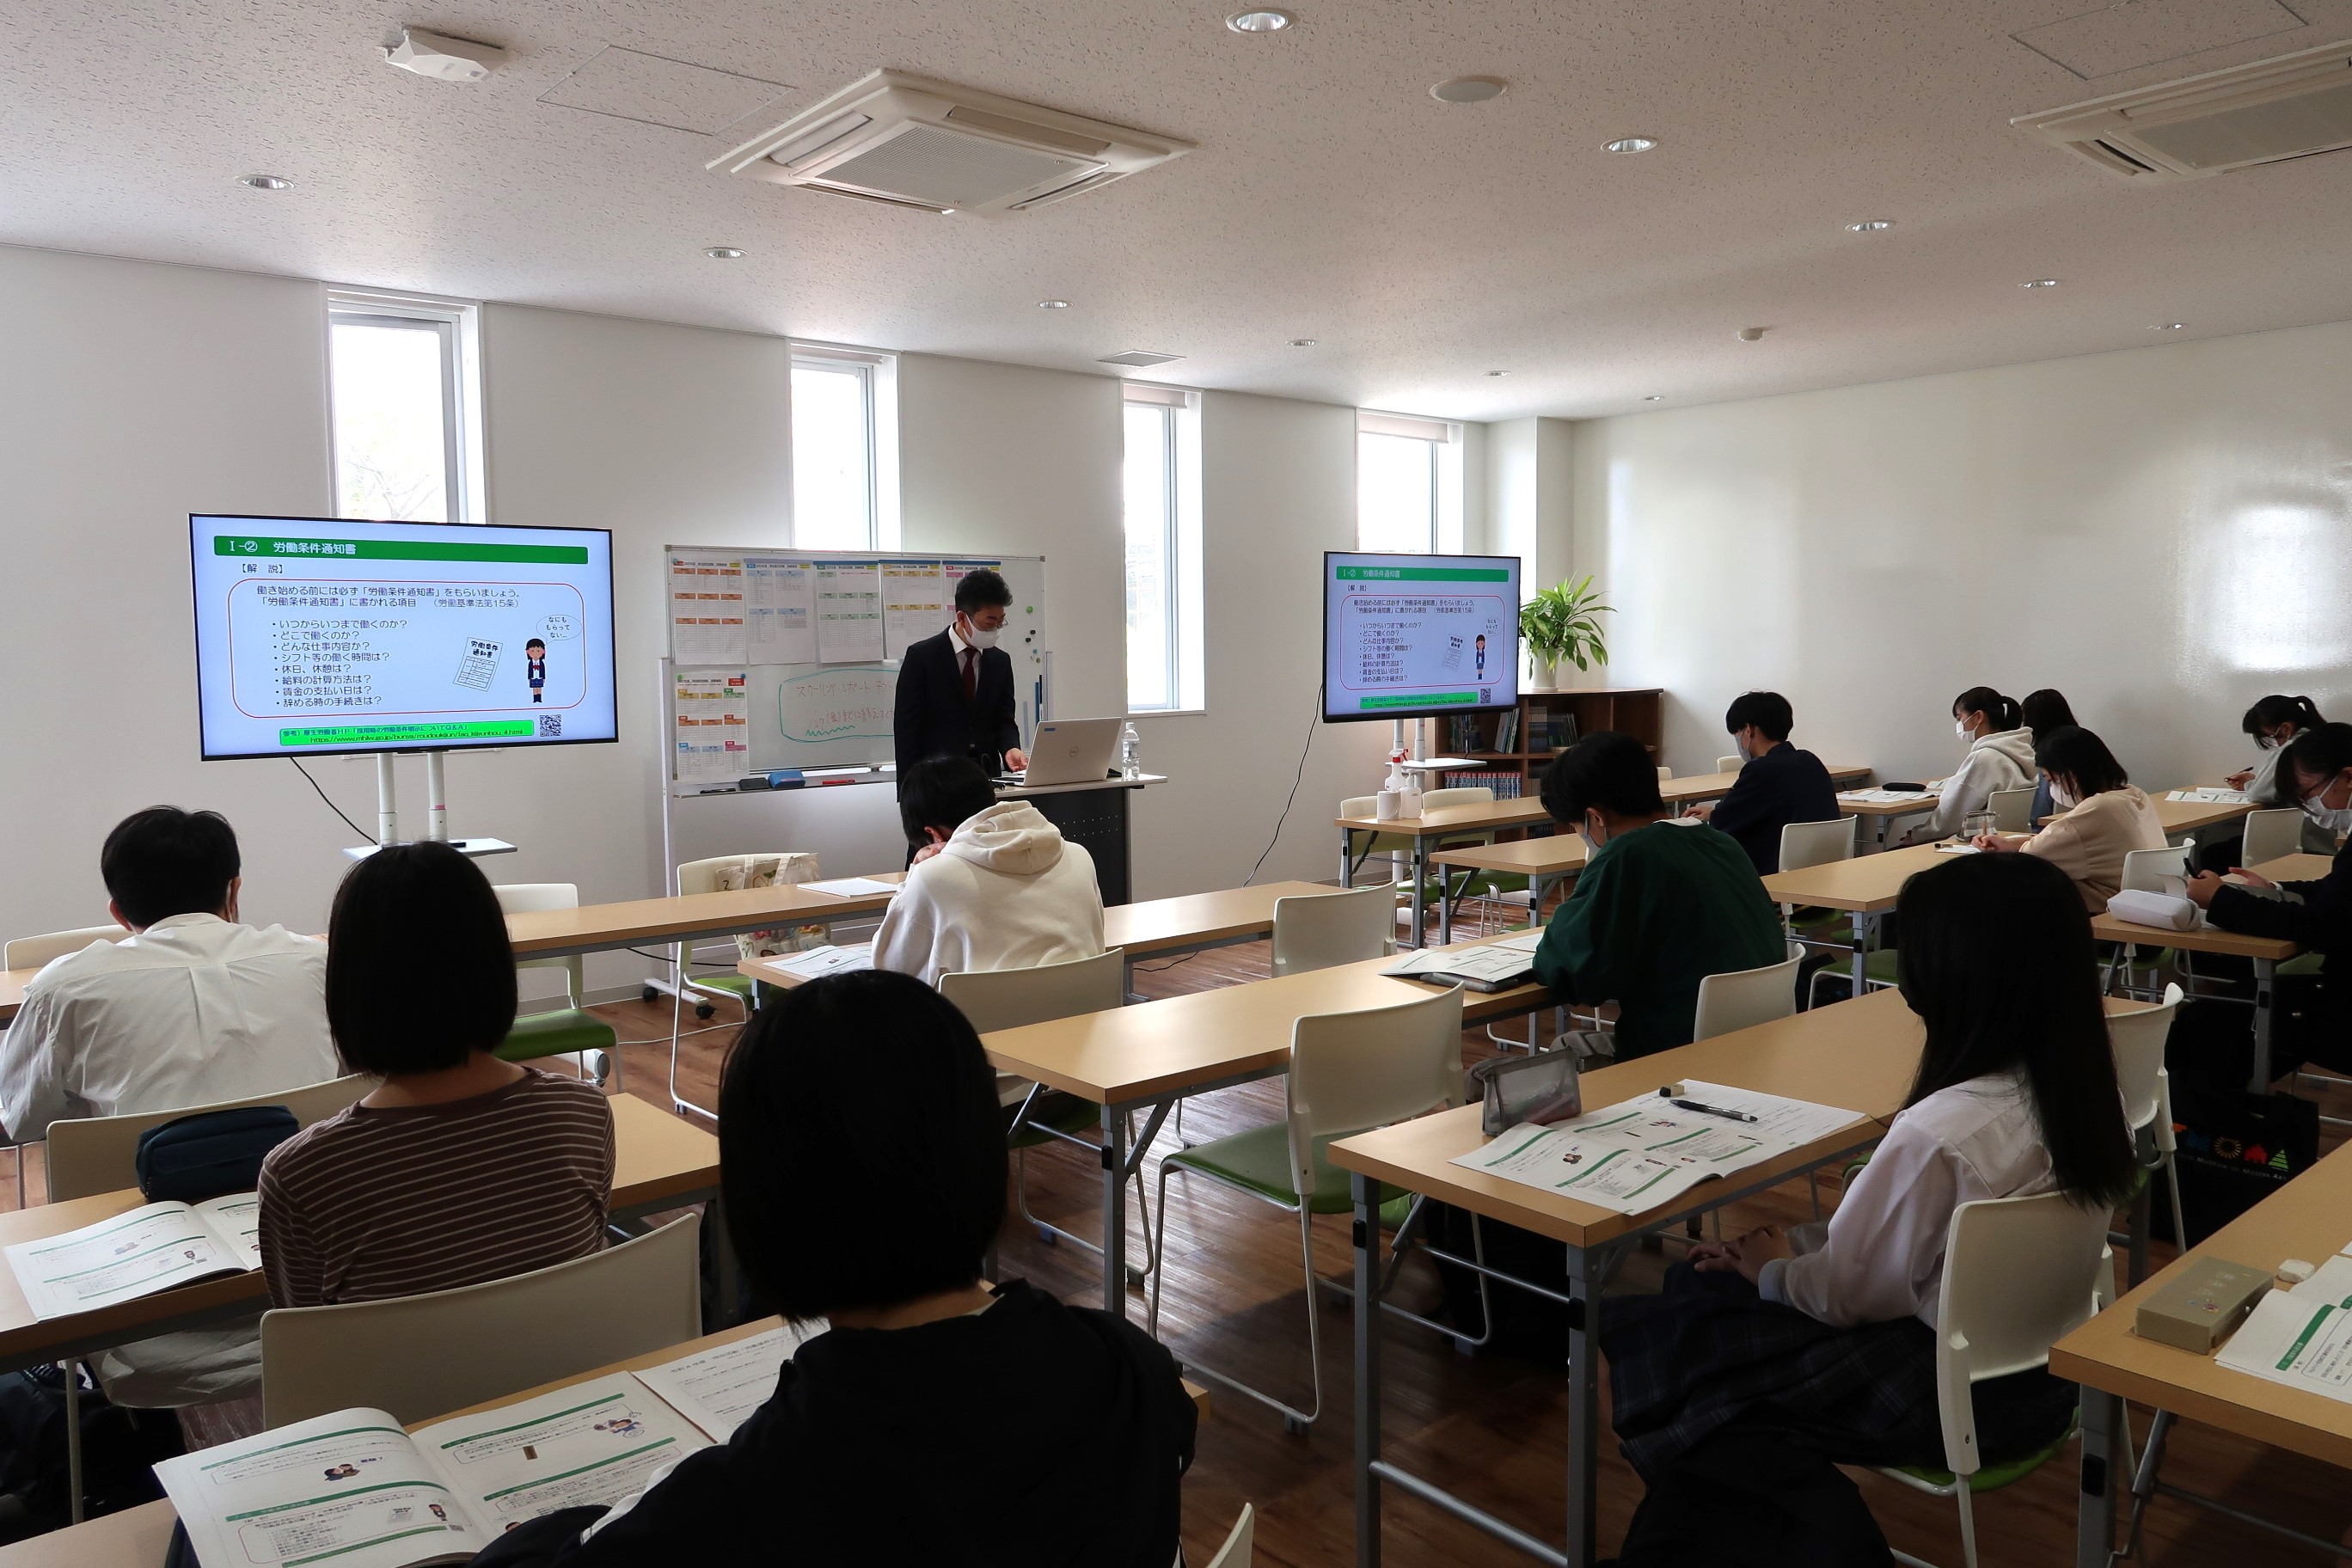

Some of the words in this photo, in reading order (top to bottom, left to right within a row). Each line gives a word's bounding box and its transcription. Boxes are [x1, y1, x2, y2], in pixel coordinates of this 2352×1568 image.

[273, 542, 357, 555] 労働条件通知書
[257, 585, 521, 597] 働き始める前には必ず「労働条件通知書」をもらいましょう。
[261, 597, 416, 608] 「労働条件通知書」に書かれる項目
[470, 640, 499, 652] 労働条件
[472, 648, 493, 658] 通知書
